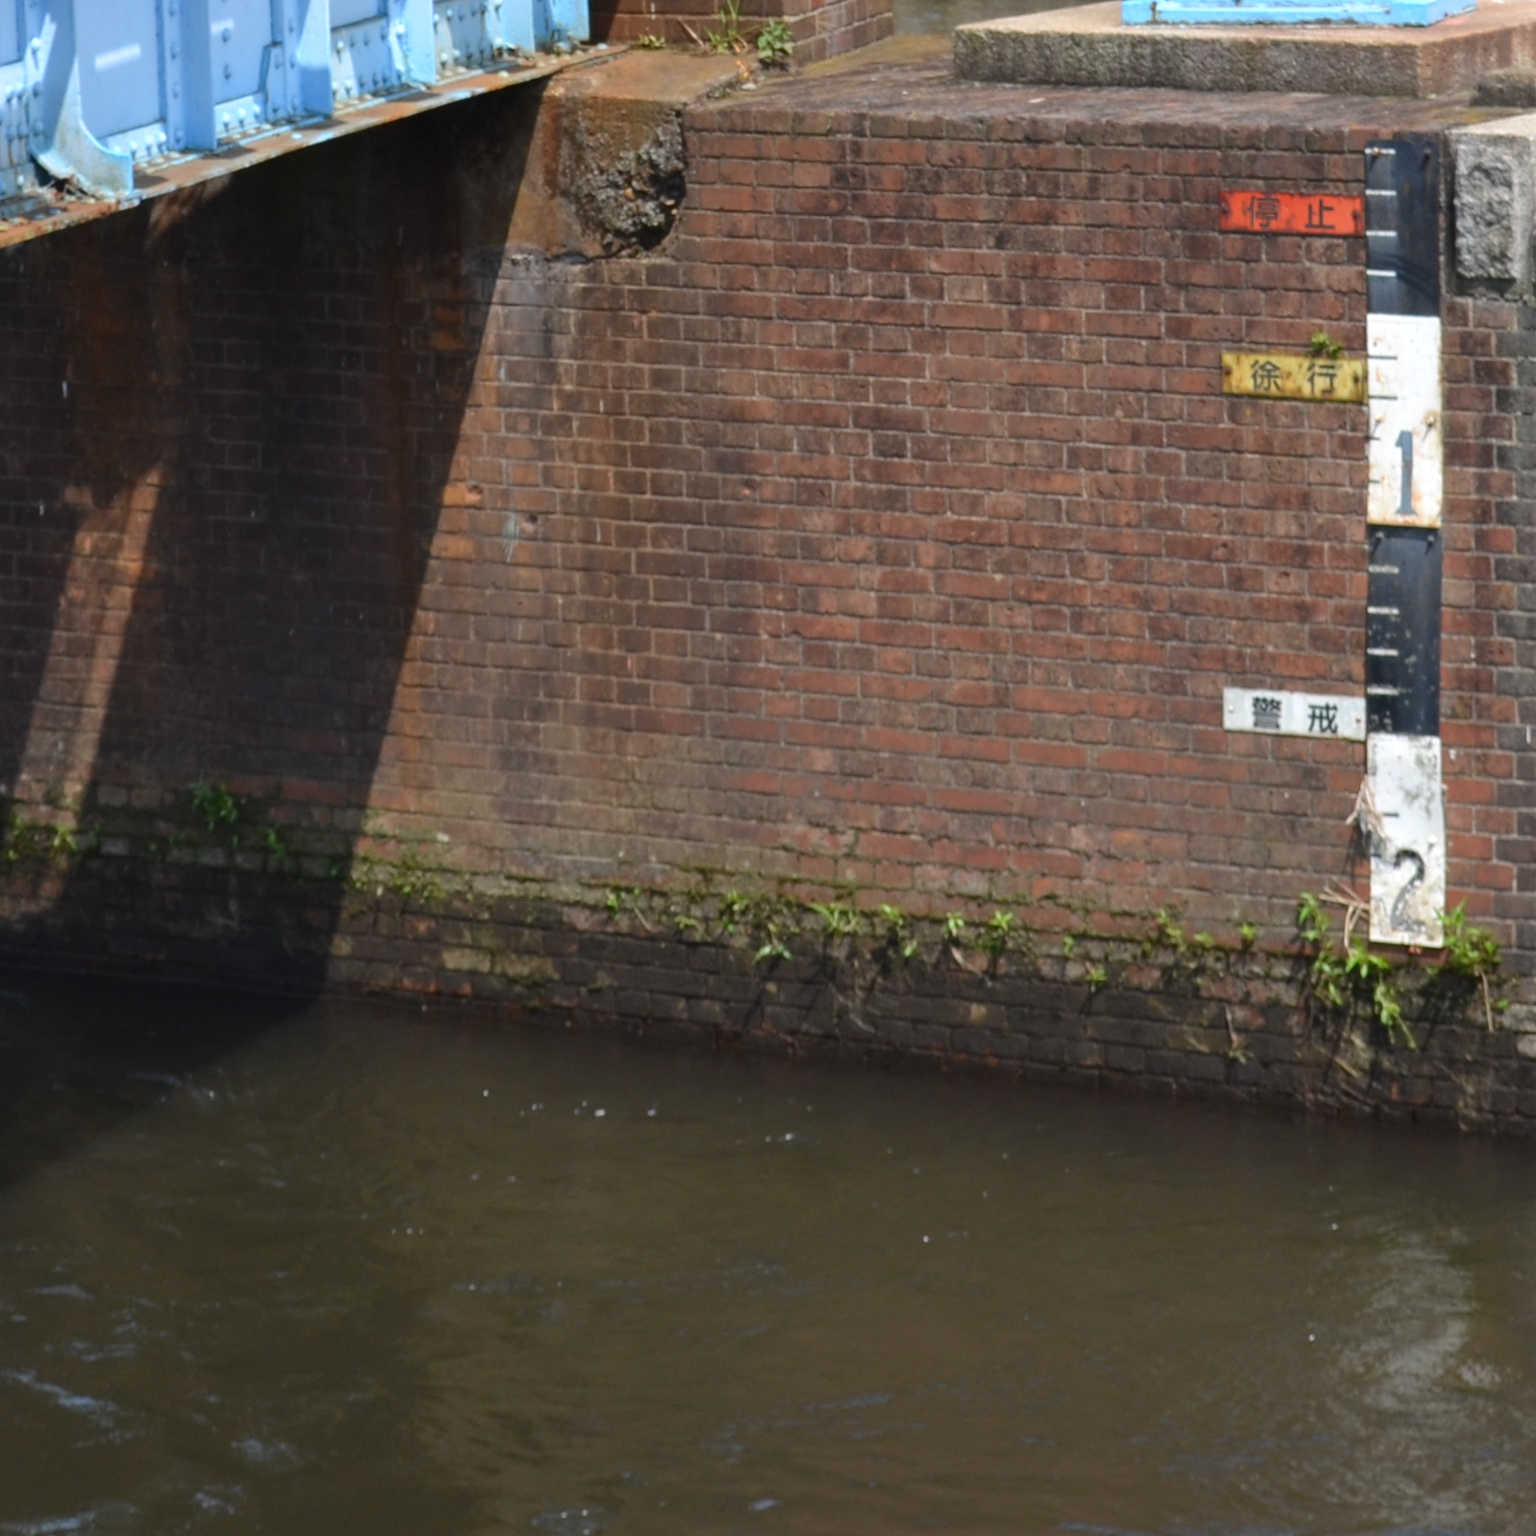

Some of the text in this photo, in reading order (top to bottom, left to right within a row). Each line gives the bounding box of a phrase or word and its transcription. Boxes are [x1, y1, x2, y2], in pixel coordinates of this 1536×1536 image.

[1248, 196, 1336, 231] 停止
[1251, 359, 1338, 396] 徐行
[1395, 430, 1419, 516] 1
[1251, 696, 1339, 735] 警戒
[1388, 850, 1426, 933] 2
